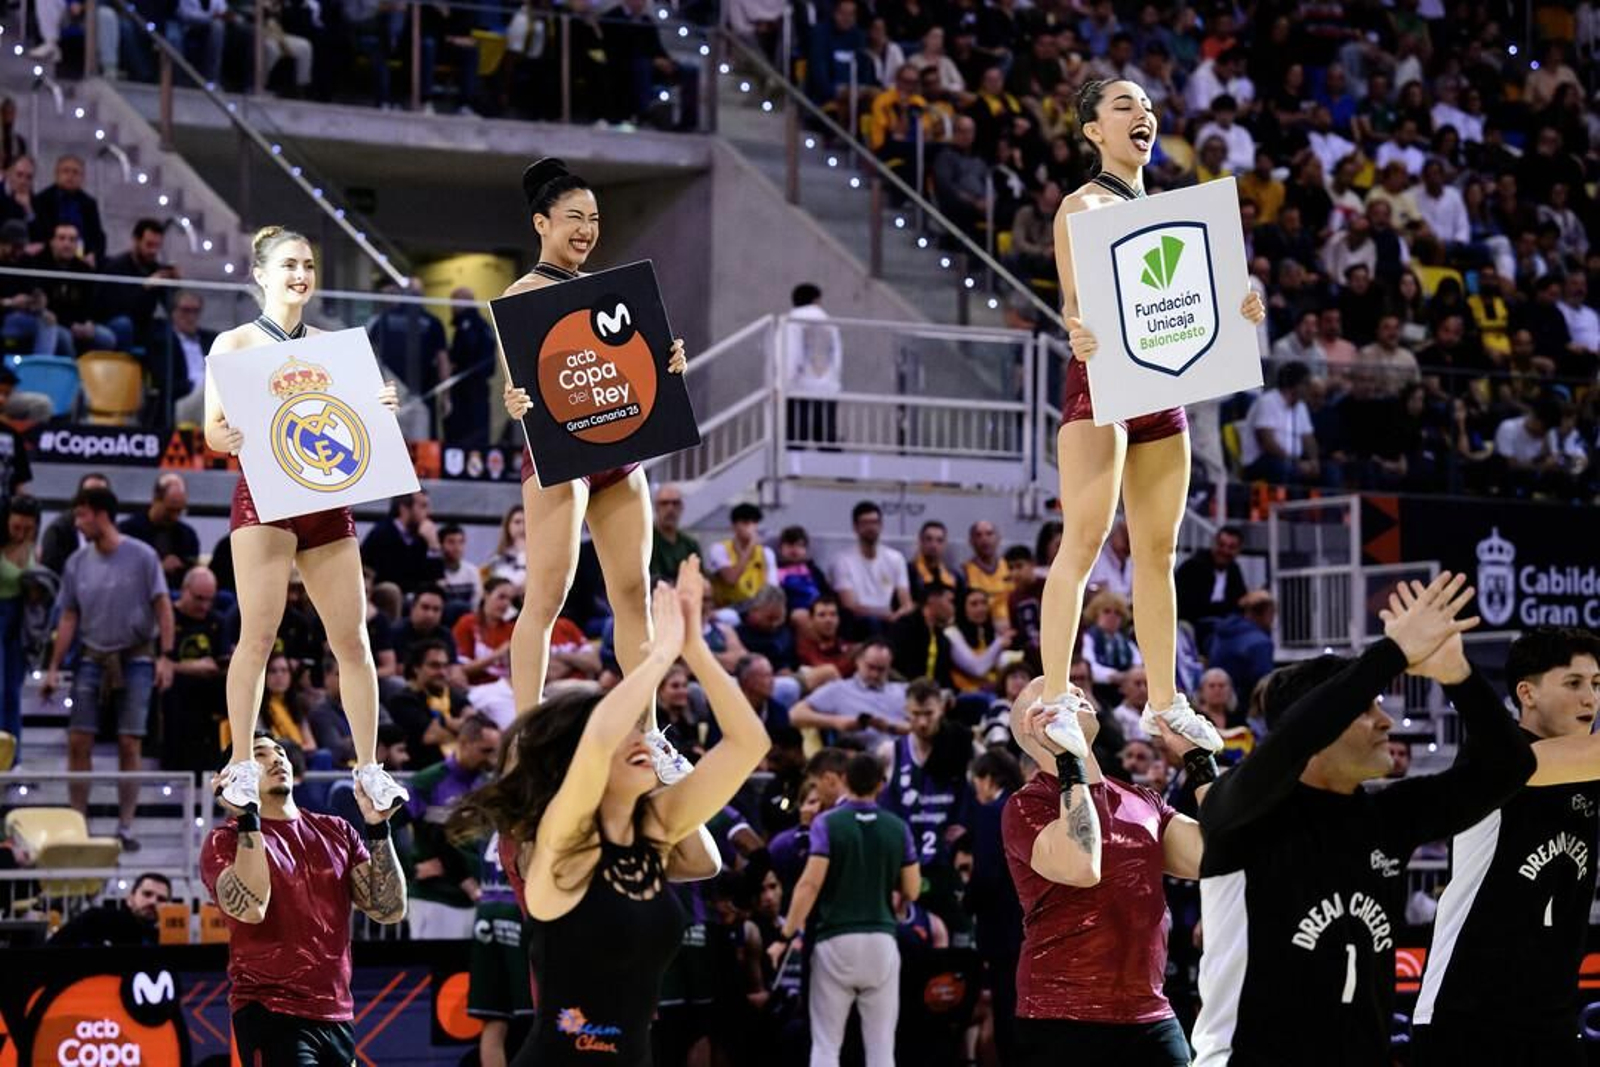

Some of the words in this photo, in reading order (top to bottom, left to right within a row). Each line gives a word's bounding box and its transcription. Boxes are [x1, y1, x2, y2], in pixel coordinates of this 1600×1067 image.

[1135, 290, 1200, 317] Fundación
[1147, 311, 1195, 333] Unicaja
[1140, 325, 1205, 349] Baloncesto
[566, 349, 597, 367] acb
[559, 362, 616, 387] Copa
[568, 390, 590, 405] del
[592, 383, 629, 407] Rey
[566, 419, 590, 431] Gran
[590, 408, 626, 425] Canaria
[39, 431, 159, 458] #CopaACB
[1520, 597, 1579, 626] Gran
[922, 830, 937, 855] 2
[1349, 892, 1393, 953] CHEERS
[1341, 944, 1357, 1004] 1
[75, 1018, 120, 1039] acb
[57, 1038, 141, 1067] Copa
